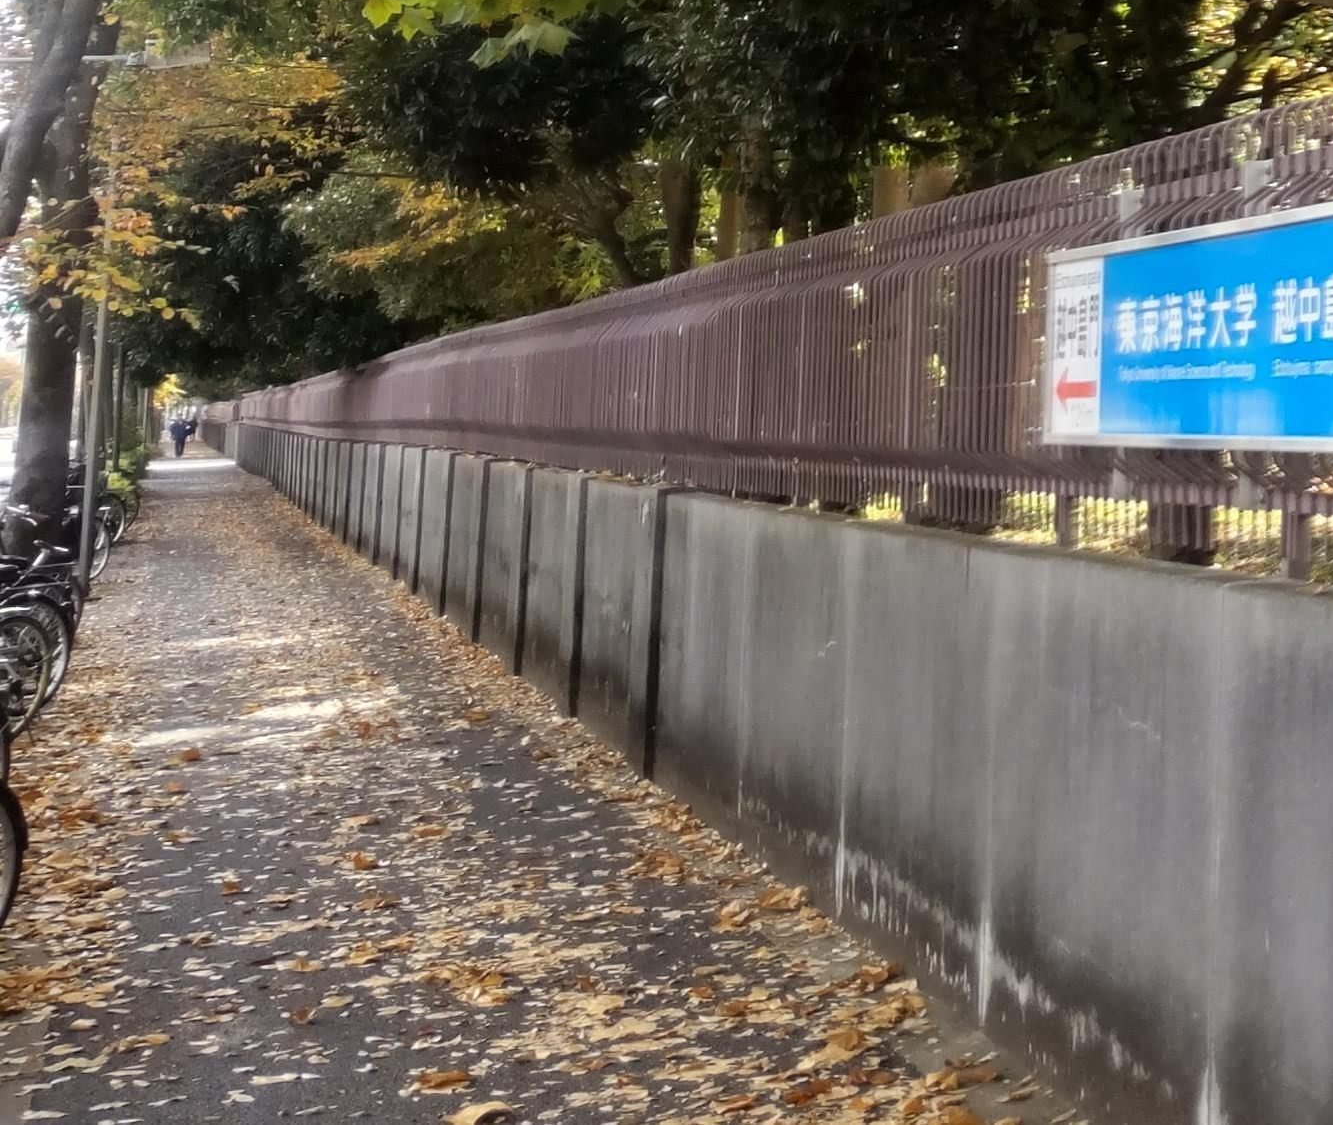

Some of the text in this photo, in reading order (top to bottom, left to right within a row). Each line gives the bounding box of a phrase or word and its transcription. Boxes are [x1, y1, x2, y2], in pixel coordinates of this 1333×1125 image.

[1114, 283, 1257, 354] 東京海洋大学
